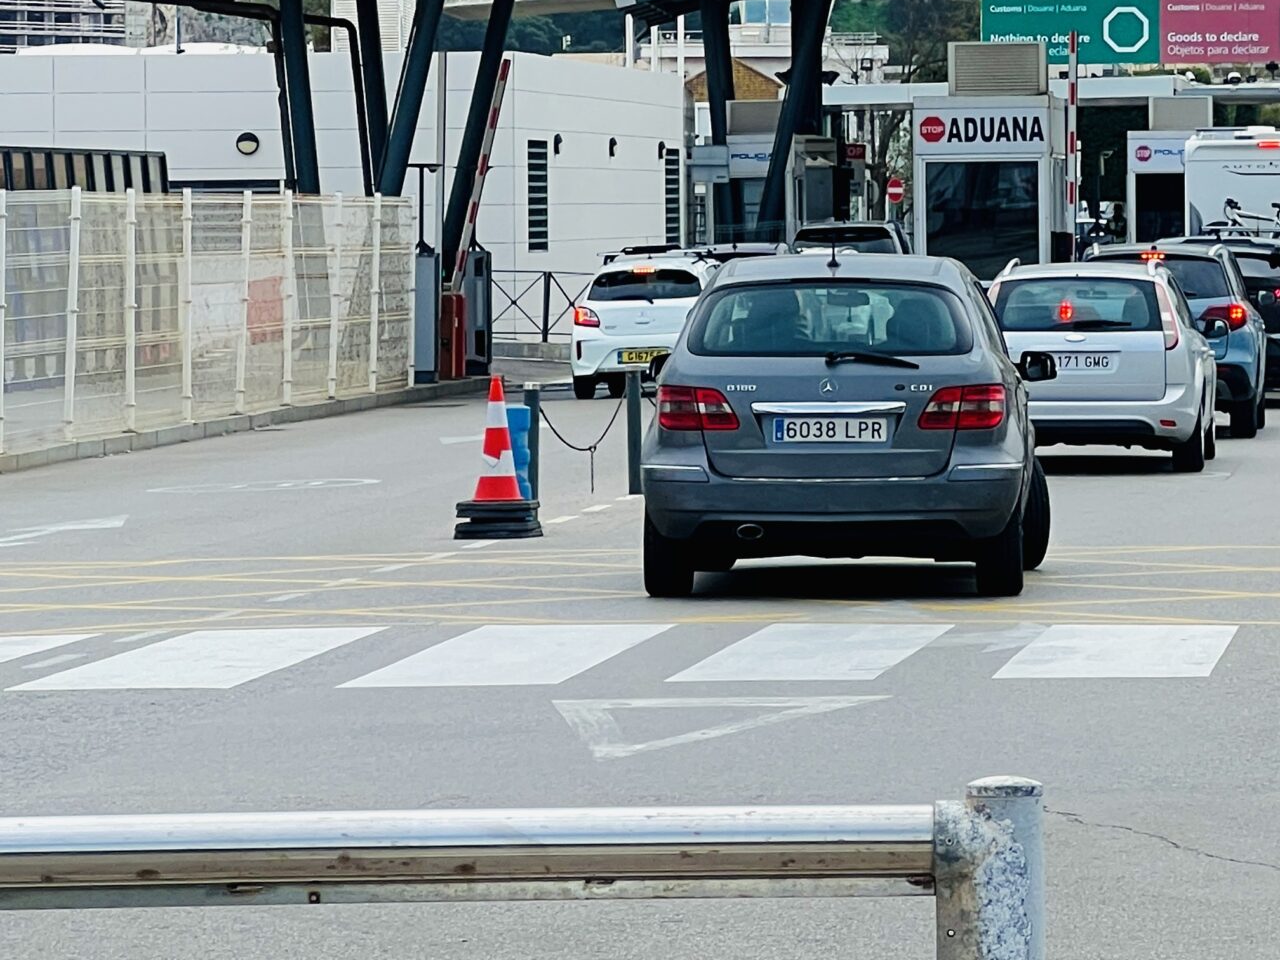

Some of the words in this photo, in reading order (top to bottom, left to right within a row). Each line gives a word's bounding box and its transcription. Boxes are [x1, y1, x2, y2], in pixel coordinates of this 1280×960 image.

[989, 5, 1022, 13] Customs
[1060, 4, 1087, 12] Aduana
[1167, 3, 1200, 11] Customs
[1205, 3, 1232, 11] Douane
[1238, 3, 1265, 11] Aduana
[1037, 34, 1049, 43] to
[1167, 32, 1202, 42] Goods
[1205, 32, 1217, 42] to
[1219, 32, 1259, 42] declare
[1167, 44, 1205, 57] Objetos
[1207, 46, 1229, 56] para
[1231, 44, 1270, 54] declarar
[921, 126, 944, 134] STOP
[946, 116, 1045, 143] ADUANA
[1057, 355, 1079, 368] 171
[1084, 355, 1109, 368] GMG
[786, 421, 836, 439] 6038
[845, 421, 882, 439] LPR
